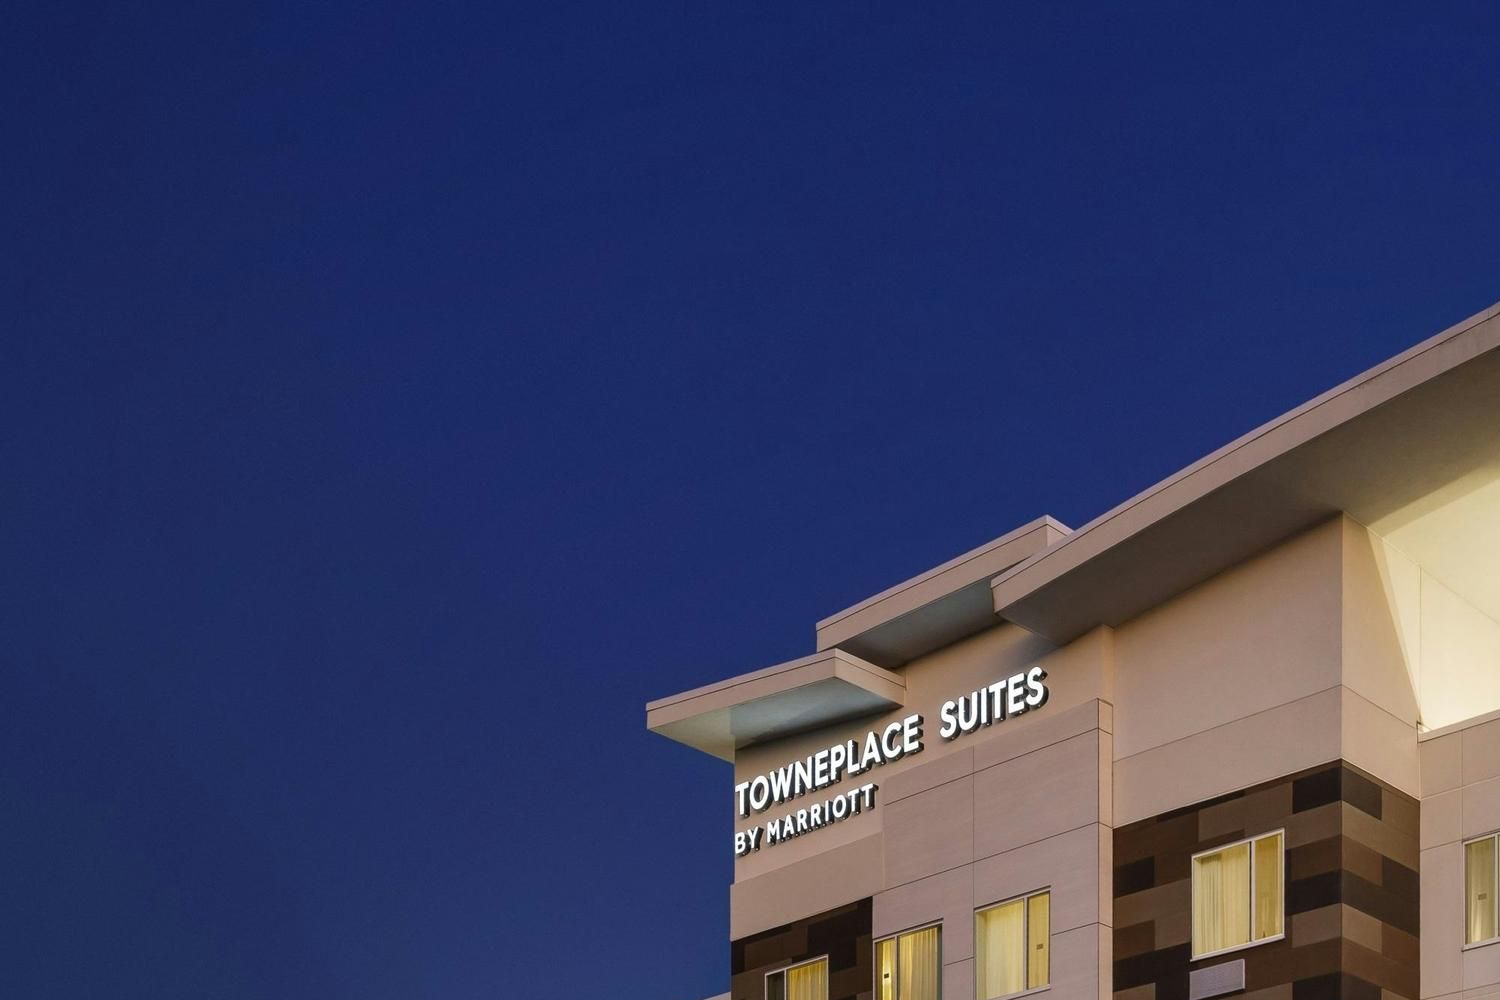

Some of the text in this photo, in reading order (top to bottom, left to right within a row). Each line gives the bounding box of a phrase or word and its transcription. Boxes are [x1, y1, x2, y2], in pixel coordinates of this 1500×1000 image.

[735, 666, 1048, 817] TOWNEPLACE SUITES
[735, 783, 879, 855] BY MARRIOTT
